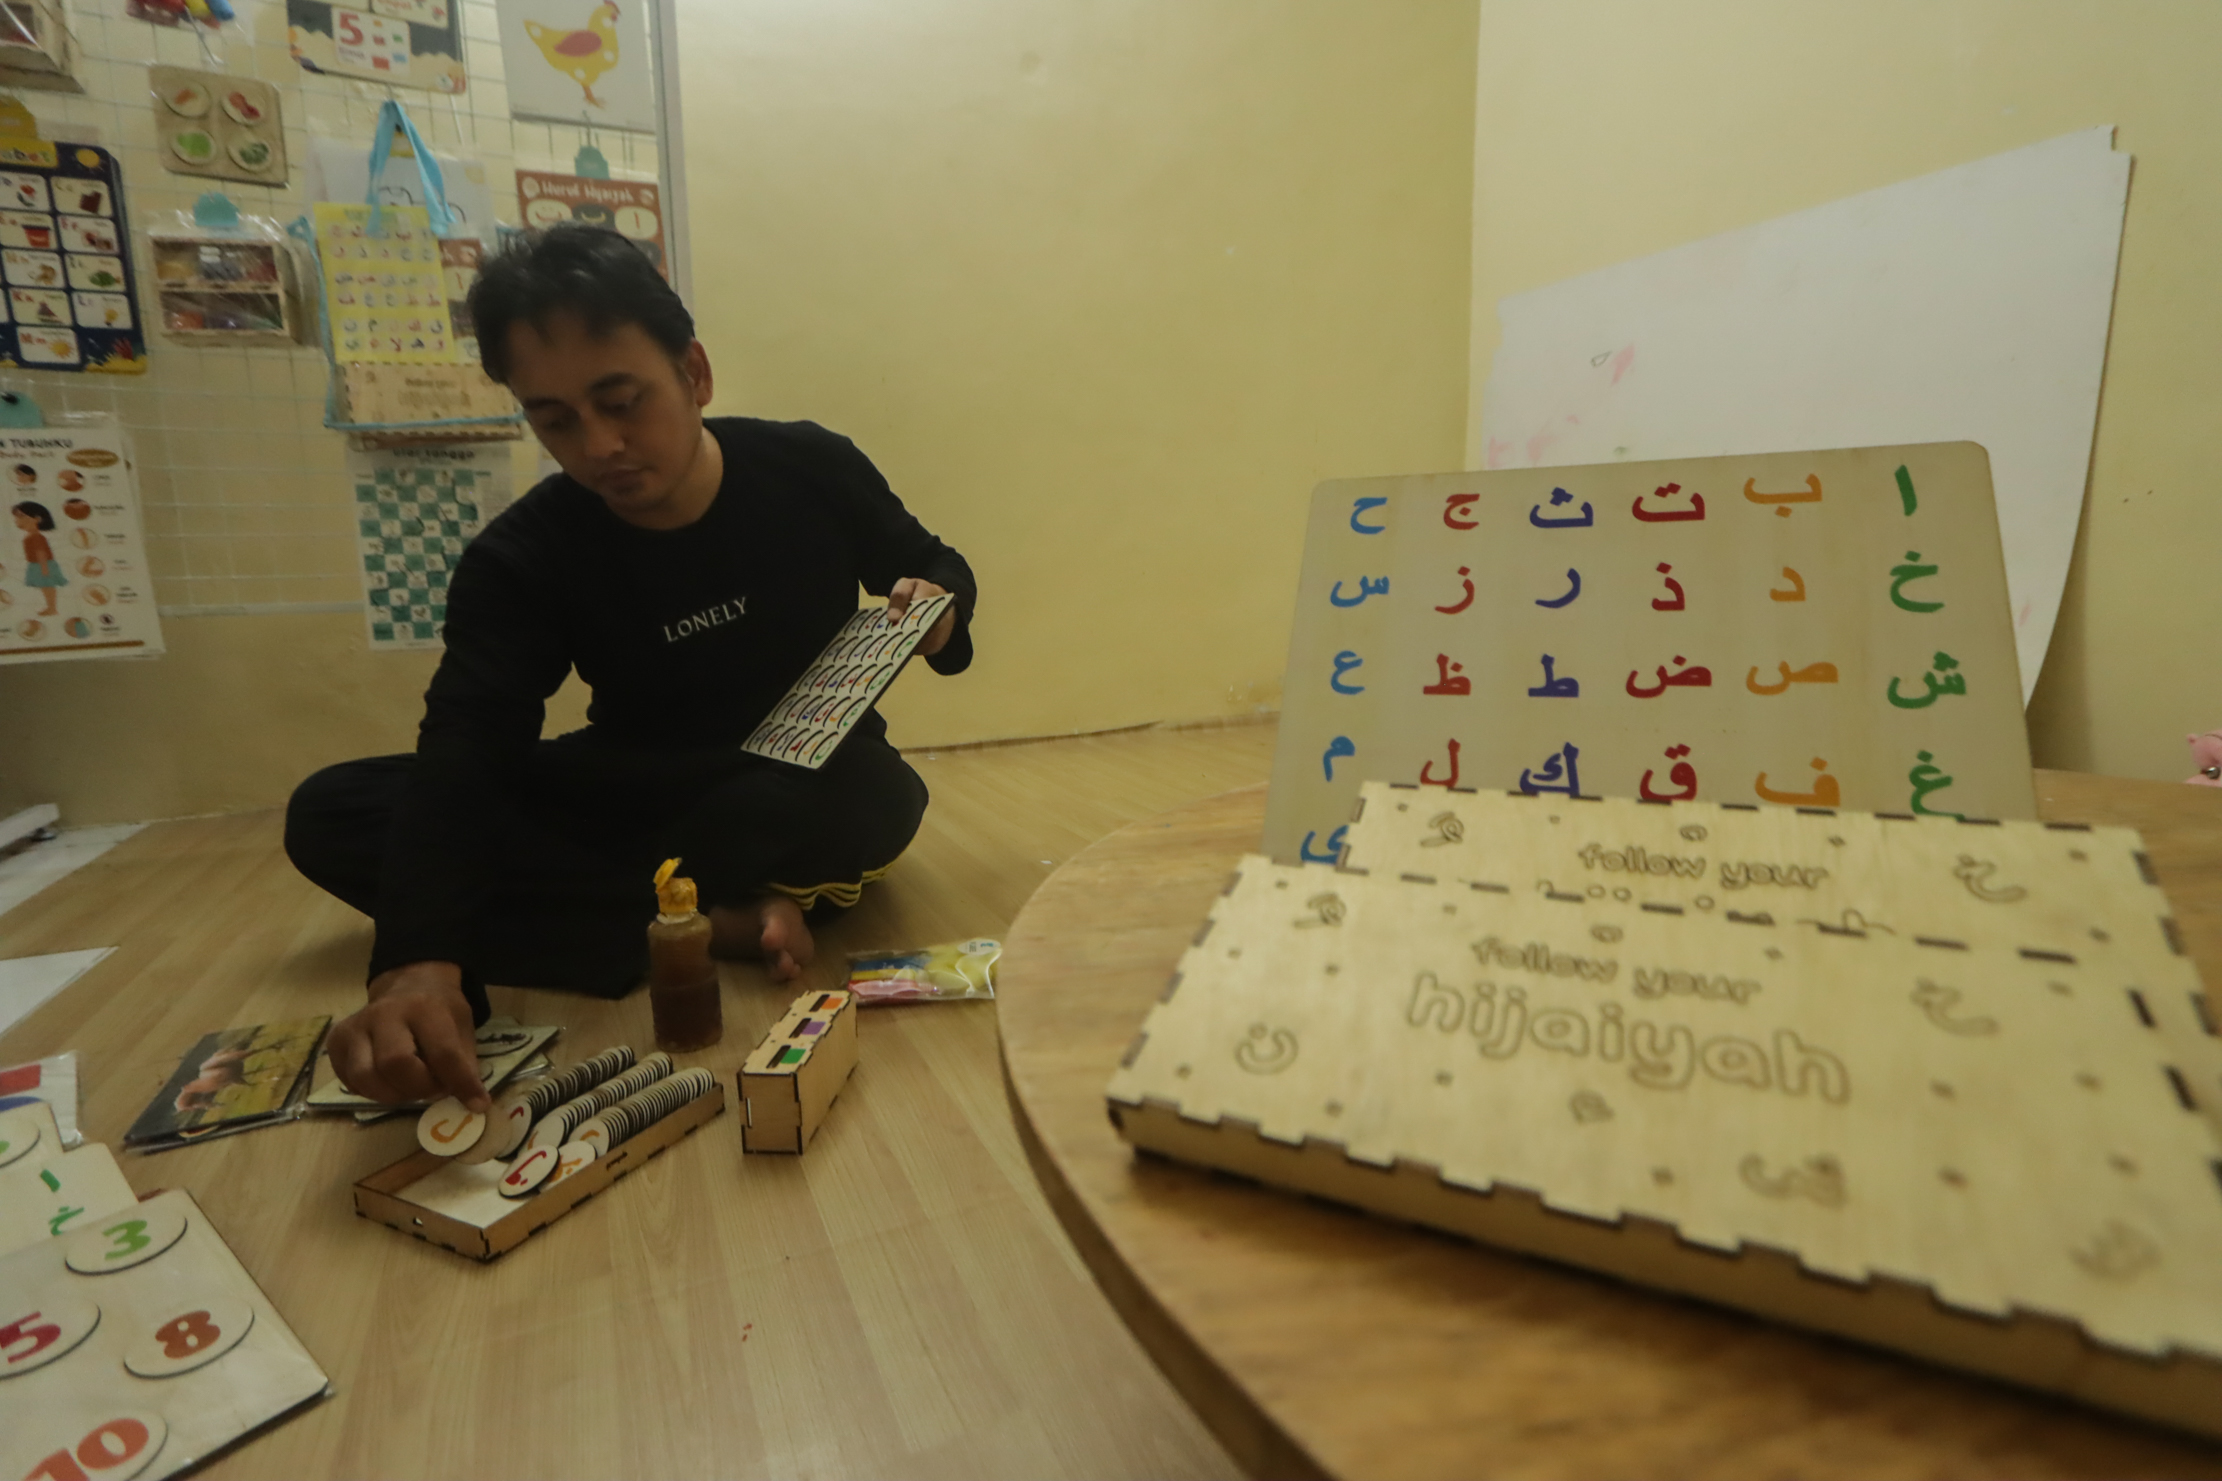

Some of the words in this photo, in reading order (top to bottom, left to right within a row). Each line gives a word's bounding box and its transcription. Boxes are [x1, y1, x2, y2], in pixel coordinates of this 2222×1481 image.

[339, 12, 364, 46] 5
[1442, 493, 1481, 530] ج
[1529, 486, 1594, 529] ث
[1632, 481, 1706, 522] ت
[1743, 474, 1823, 518] ب
[1895, 465, 1918, 516] ا
[1350, 496, 1388, 535] ح
[1329, 575, 1390, 608] س
[1434, 566, 1475, 614] ز
[1535, 568, 1581, 609] ر
[1651, 562, 1686, 611] ذ
[1770, 567, 1806, 602] د
[1889, 551, 1945, 613] خ
[663, 597, 747, 643] LONELY
[1330, 650, 1365, 695] ع
[1422, 653, 1472, 695] ظ
[1528, 654, 1580, 698] ط
[1625, 655, 1713, 699] ض
[1746, 661, 1839, 696] ص
[1887, 651, 1967, 709] ش
[1322, 735, 1356, 782] م
[1419, 737, 1460, 788] ل
[1518, 740, 1580, 798] ك
[1638, 742, 1698, 801] ق
[1754, 756, 1841, 807] ف
[1578, 842, 1705, 879] follow
[1720, 861, 1830, 890] your
[1471, 936, 1618, 984] follow
[1633, 966, 1762, 1006] your
[1406, 971, 1852, 1105] hijaiyah
[102, 1219, 151, 1260] 3
[0, 1311, 62, 1364] 5
[155, 1310, 221, 1360] 8
